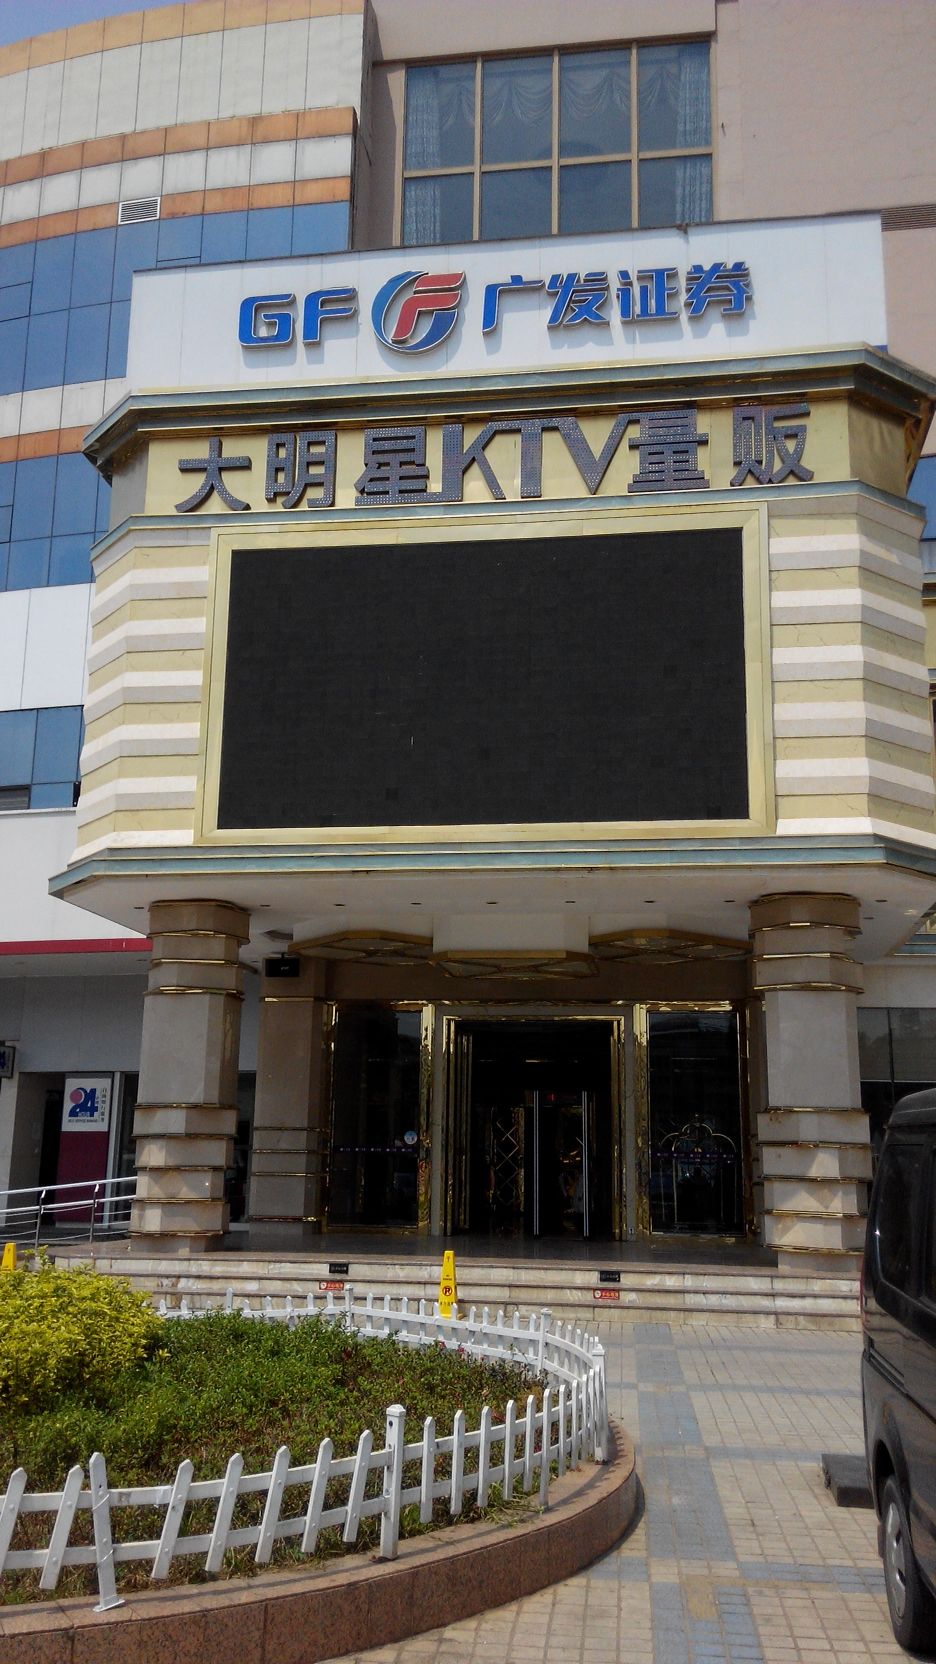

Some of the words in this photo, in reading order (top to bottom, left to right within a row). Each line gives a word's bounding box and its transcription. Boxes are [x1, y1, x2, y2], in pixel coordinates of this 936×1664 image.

[238, 286, 358, 347] GF
[482, 261, 753, 334] 广发证券
[174, 401, 815, 513] 大明星KTV量贩
[68, 1087, 99, 1118] 24
